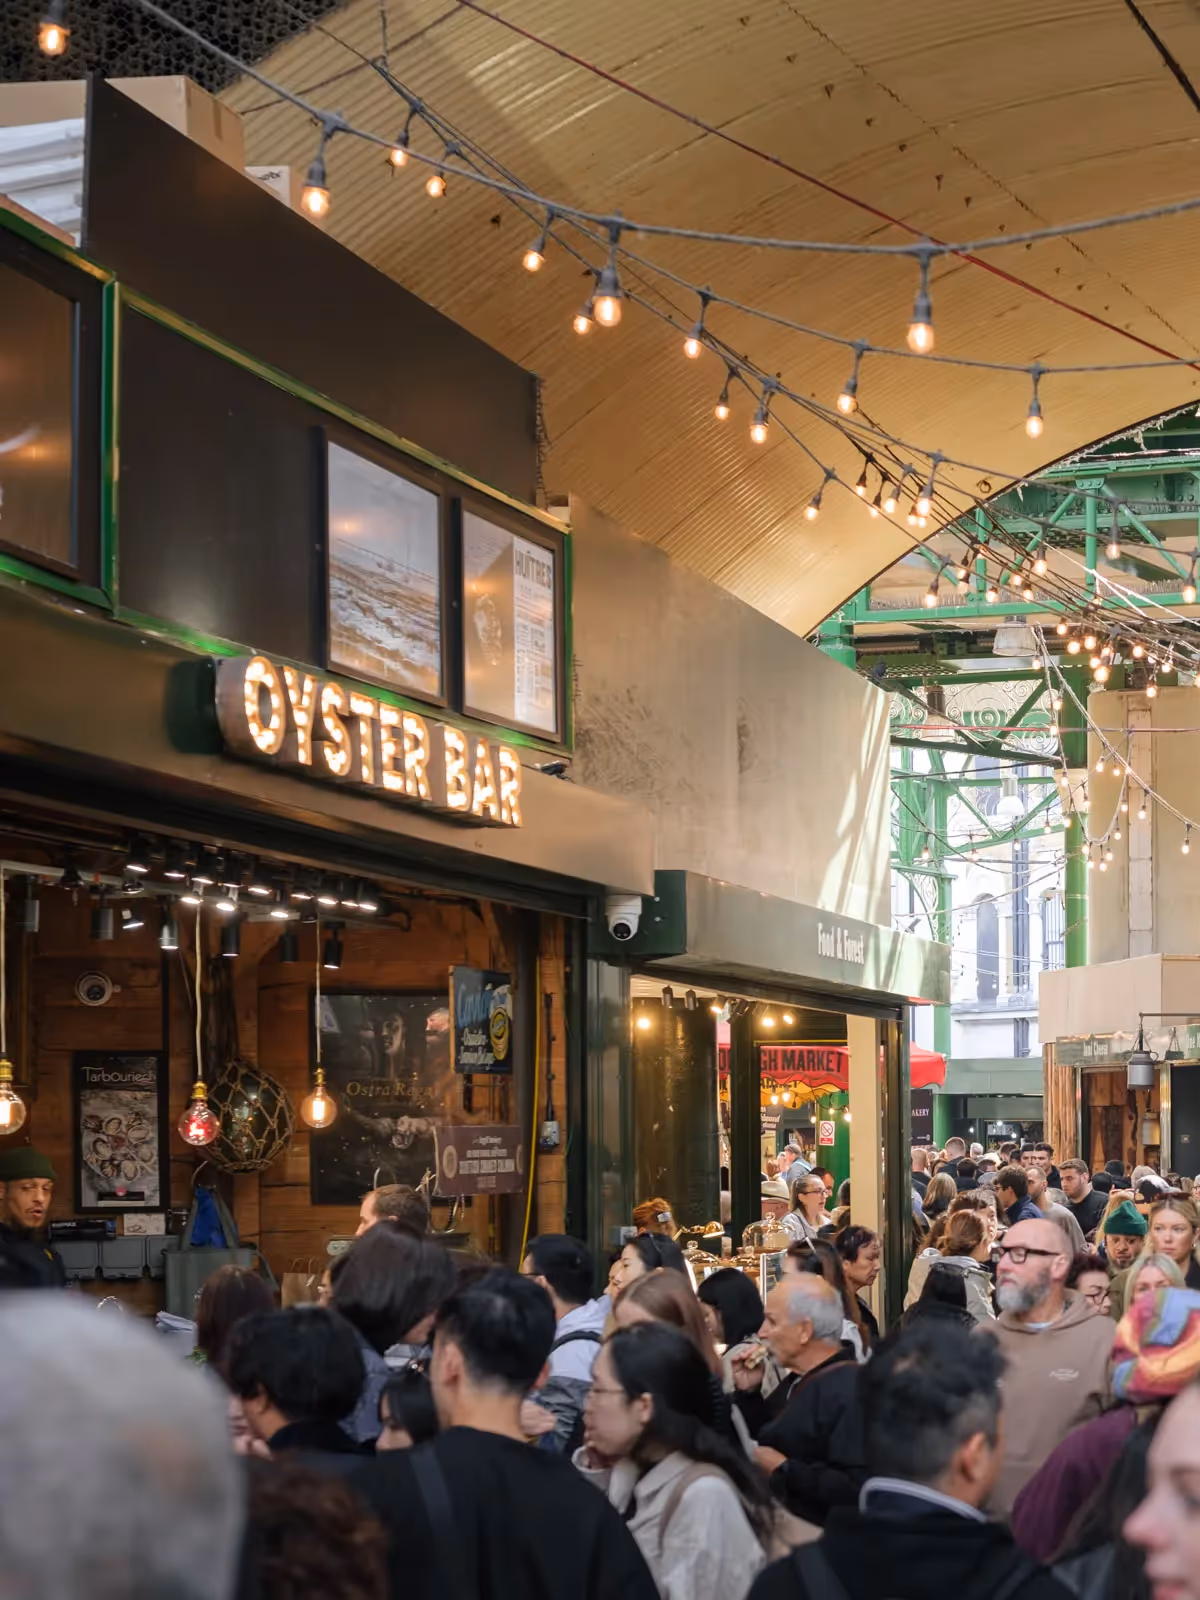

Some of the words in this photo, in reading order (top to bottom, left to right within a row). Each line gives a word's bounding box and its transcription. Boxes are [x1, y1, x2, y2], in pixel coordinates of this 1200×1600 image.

[244, 656, 432, 801] OYSTER
[443, 724, 523, 828] BAR
[817, 922, 835, 957] Food
[843, 929, 865, 965] Forest
[781, 1050, 844, 1074] MARKET
[911, 1107, 930, 1117] AKERY
